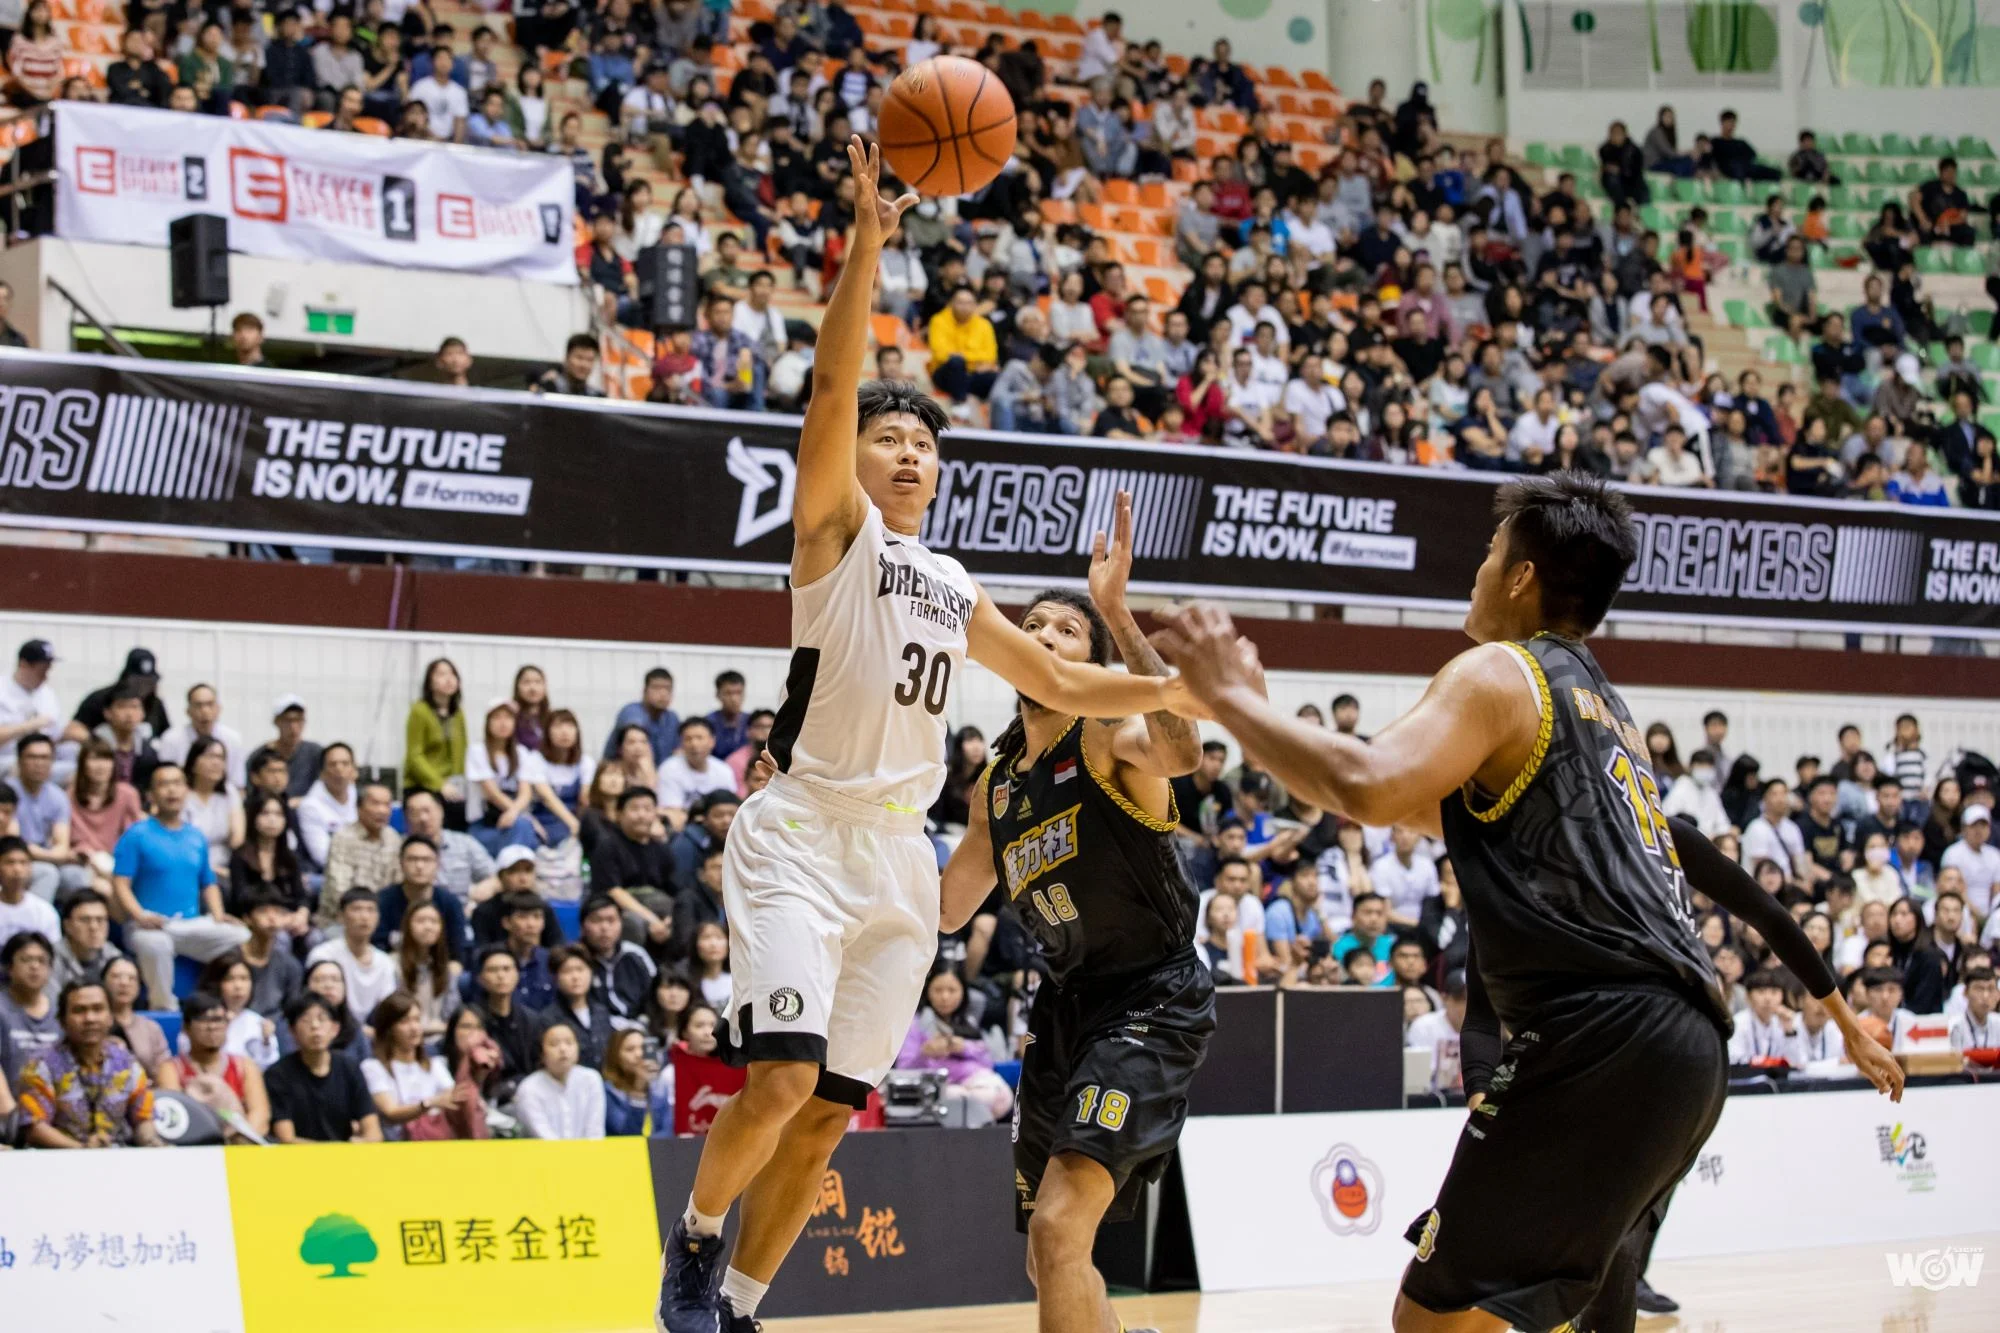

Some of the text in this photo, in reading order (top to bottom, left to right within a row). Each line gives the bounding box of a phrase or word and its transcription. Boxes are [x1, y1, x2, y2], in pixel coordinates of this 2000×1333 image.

[263, 416, 506, 472] THE FUTURE
[252, 458, 520, 507] IS NOW. #formosa
[1213, 484, 1396, 533] THE FUTURE
[1202, 521, 1236, 556] IS
[1237, 525, 1319, 563] NOW.
[1621, 512, 1835, 602] DREAMERS
[1930, 538, 1975, 571] THE
[1925, 569, 1949, 602] IS
[910, 600, 958, 634] FORMOSA
[894, 642, 951, 716] 30
[1032, 883, 1078, 926] 18
[1076, 1084, 1130, 1132] 18
[31, 1230, 197, 1271] 為夢想加油
[399, 1215, 600, 1266] 國泰金控
